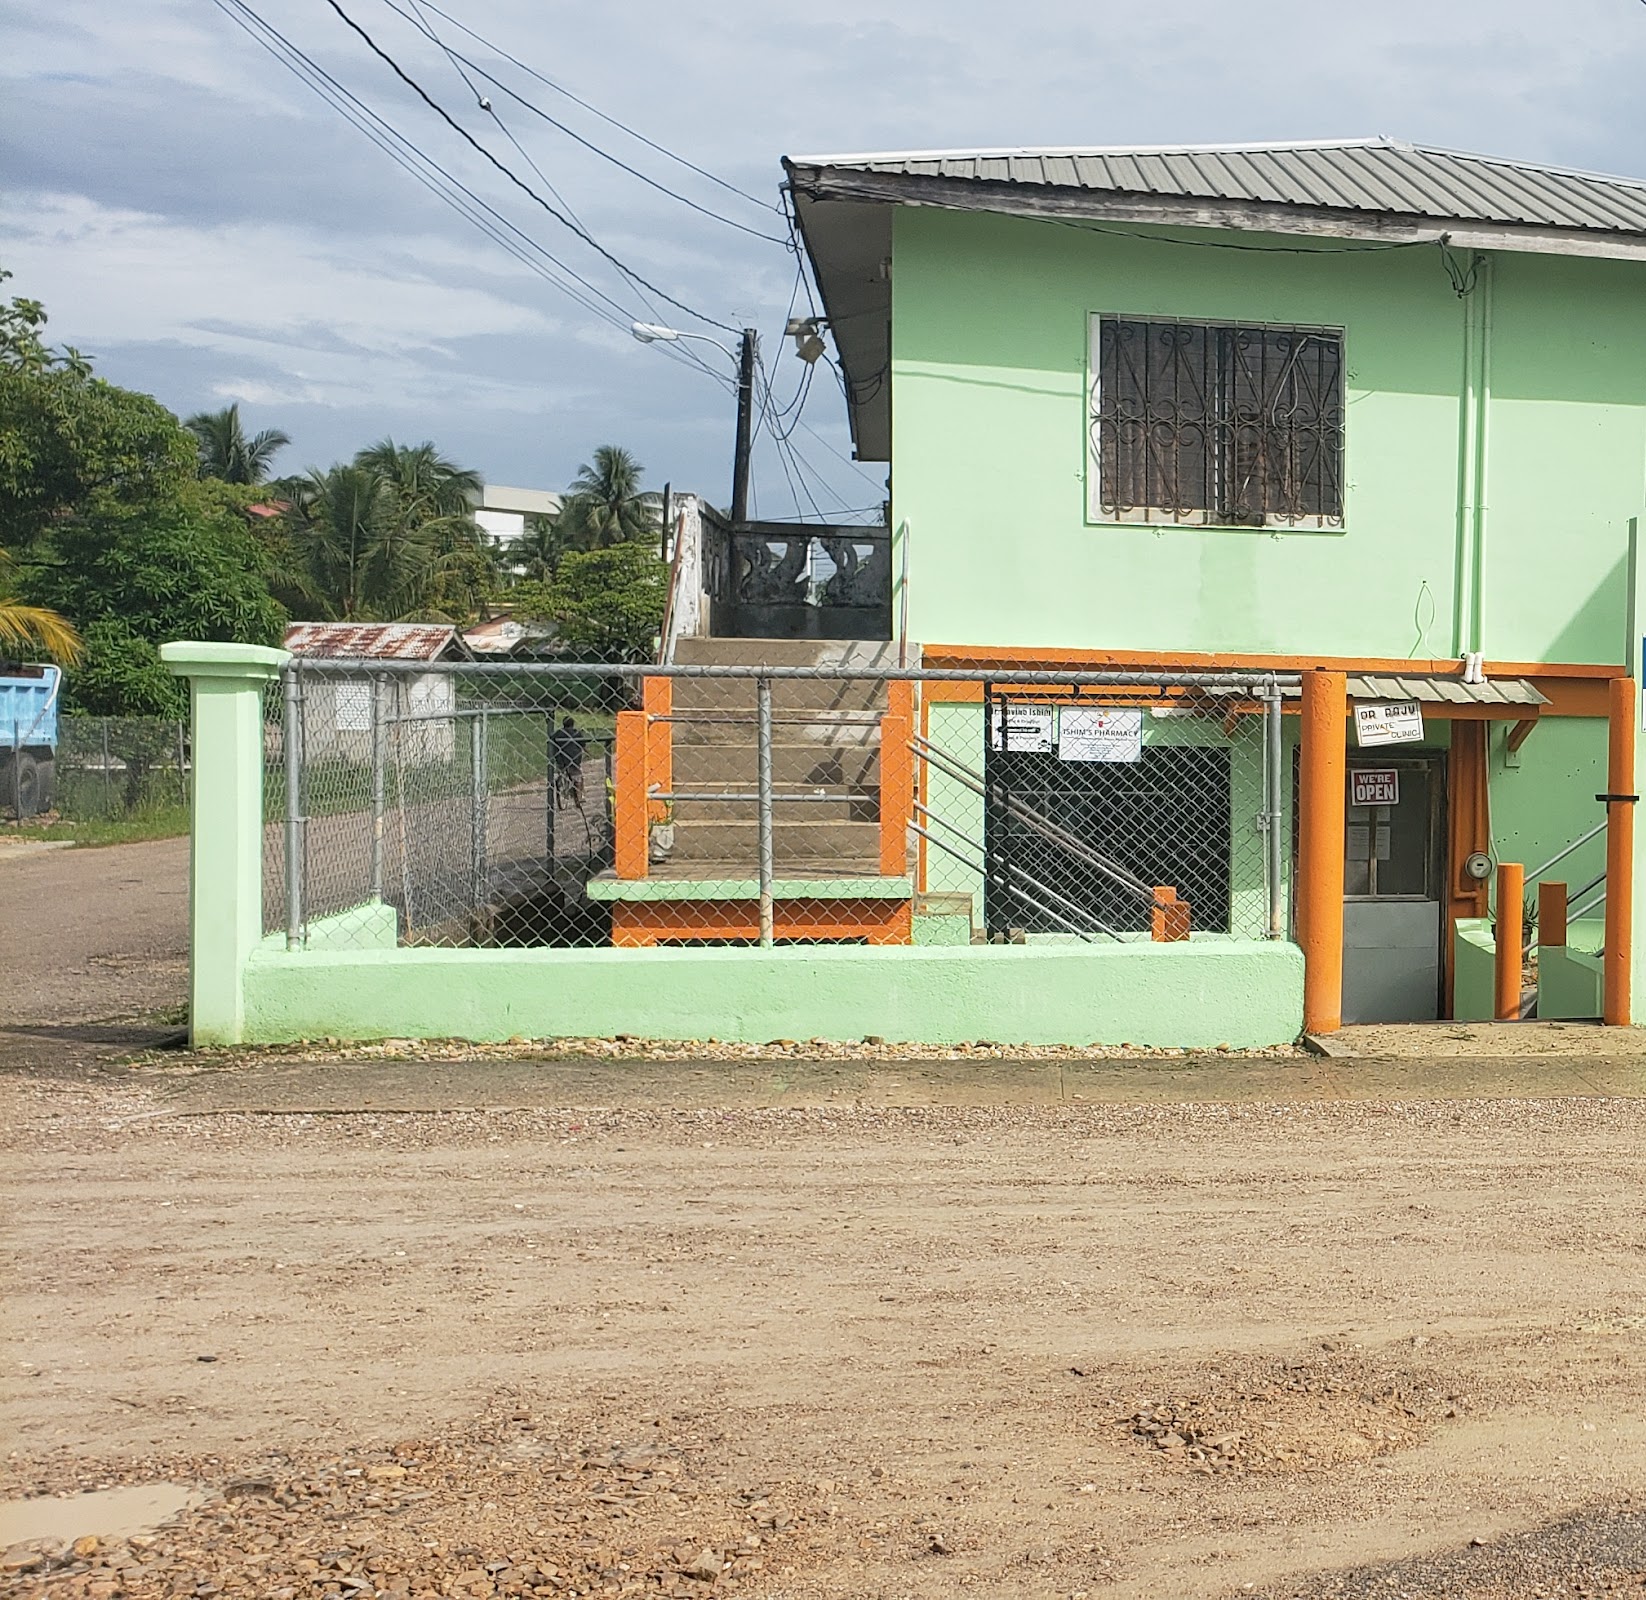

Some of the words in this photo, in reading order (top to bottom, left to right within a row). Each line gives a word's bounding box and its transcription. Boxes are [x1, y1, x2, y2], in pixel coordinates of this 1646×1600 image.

[1384, 704, 1416, 718] RAJU
[1094, 729, 1139, 738] PHARMACY
[1361, 721, 1395, 732] PRIVATE
[1390, 729, 1418, 739] CLINIC
[1358, 774, 1391, 784] WE'RE
[1355, 783, 1395, 801] OPEN
